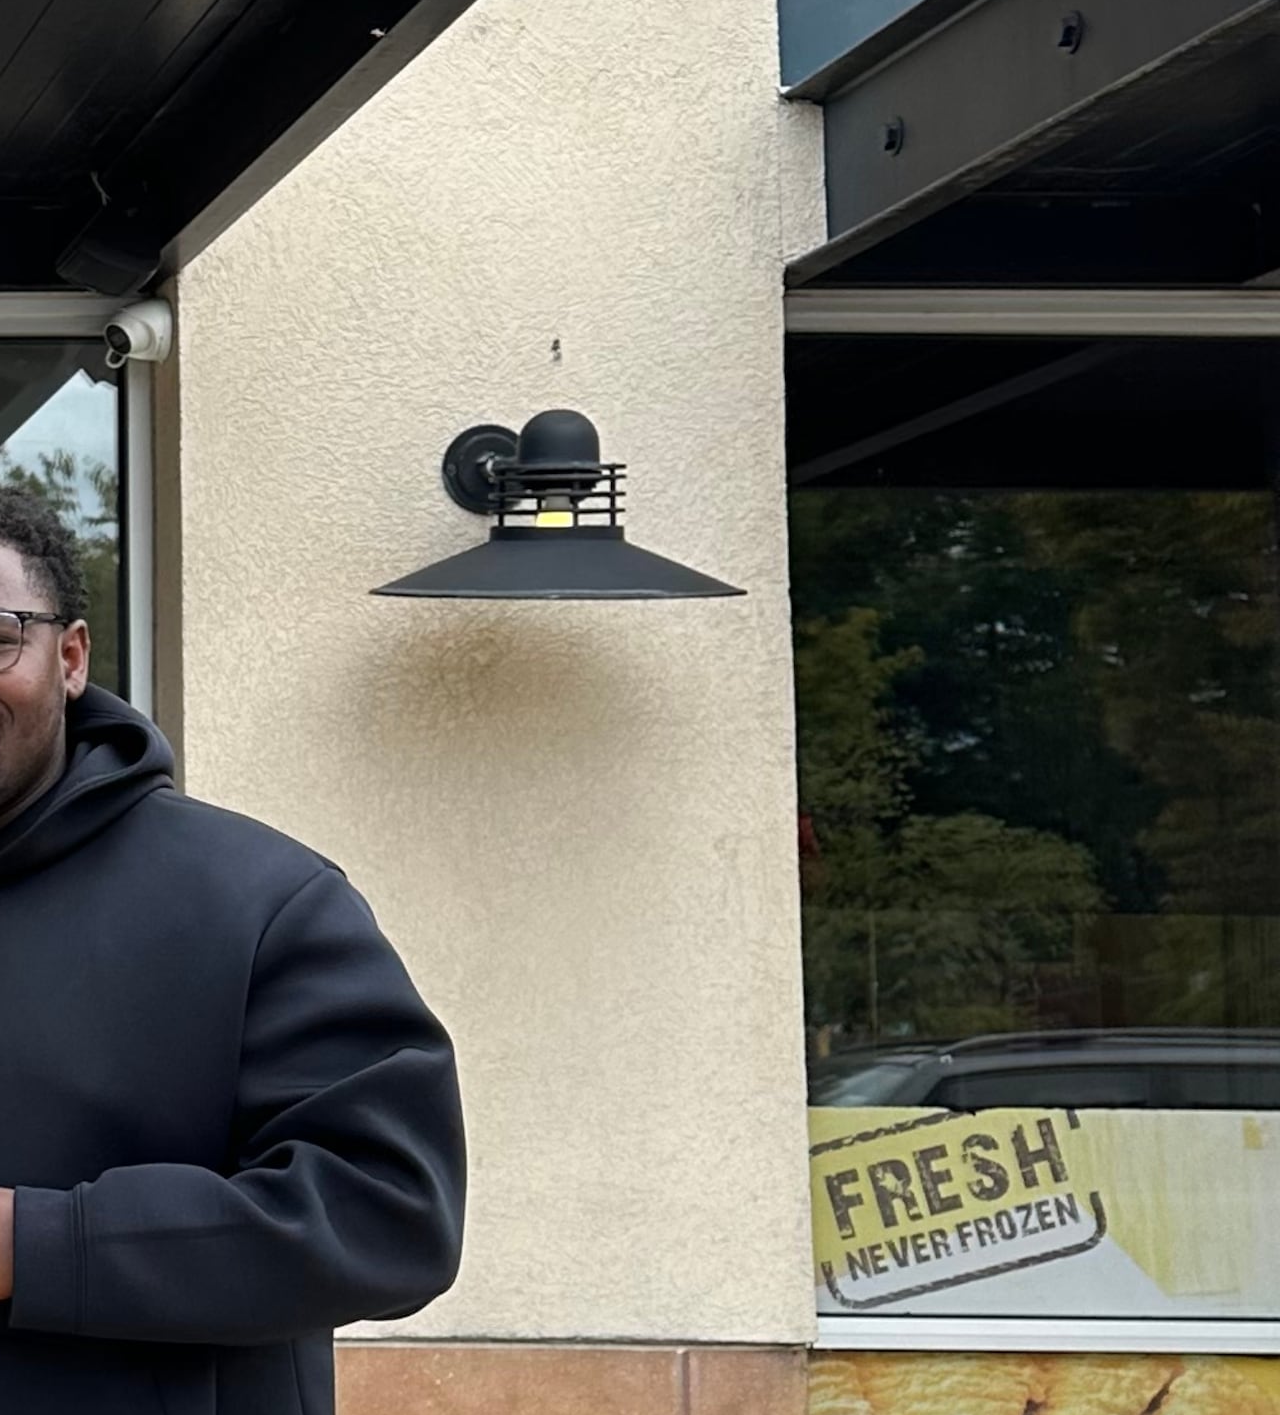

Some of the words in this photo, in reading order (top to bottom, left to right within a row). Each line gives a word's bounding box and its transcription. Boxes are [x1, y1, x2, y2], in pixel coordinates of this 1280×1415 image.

[823, 1117, 1069, 1241] FRESH
[846, 1227, 953, 1282] NEVER
[954, 1192, 1081, 1254] FROZEN
